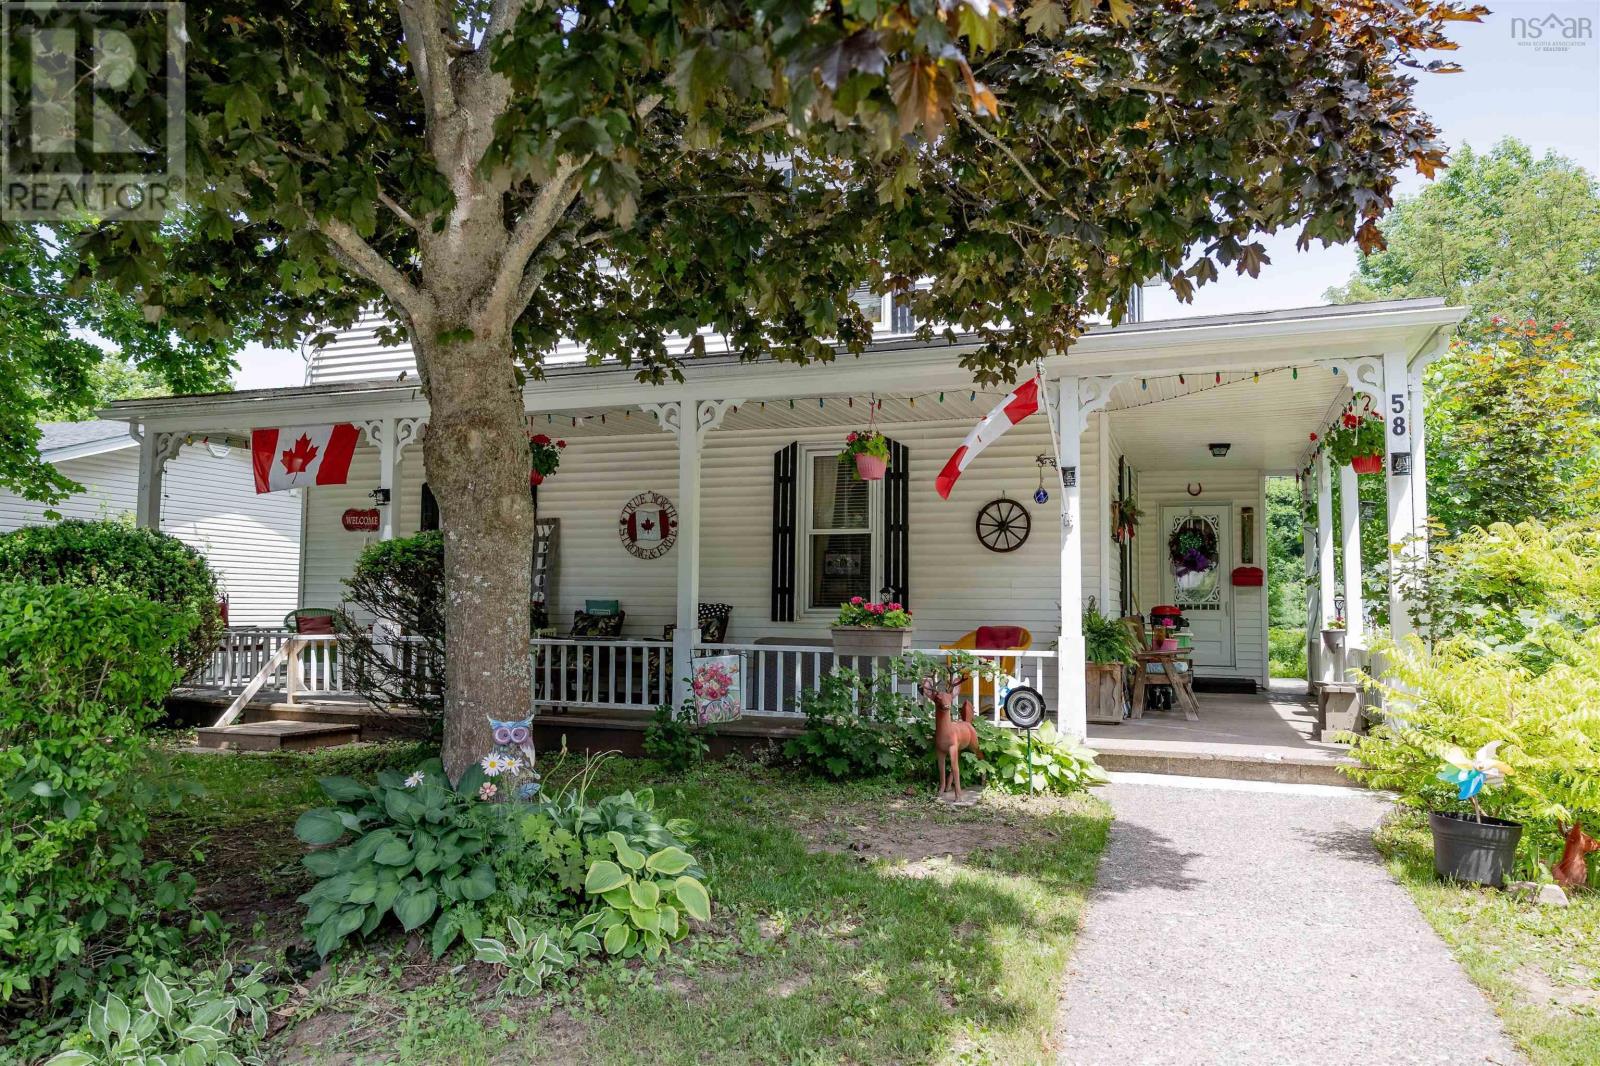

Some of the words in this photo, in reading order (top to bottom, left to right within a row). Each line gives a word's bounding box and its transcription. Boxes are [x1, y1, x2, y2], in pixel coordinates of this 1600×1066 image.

[345, 516, 379, 525] WELCOME
[622, 493, 645, 515] TRUE
[651, 493, 677, 519] NORTH
[619, 527, 648, 560] STRONG
[657, 529, 677, 557] FREE
[532, 524, 555, 613] WELCO
